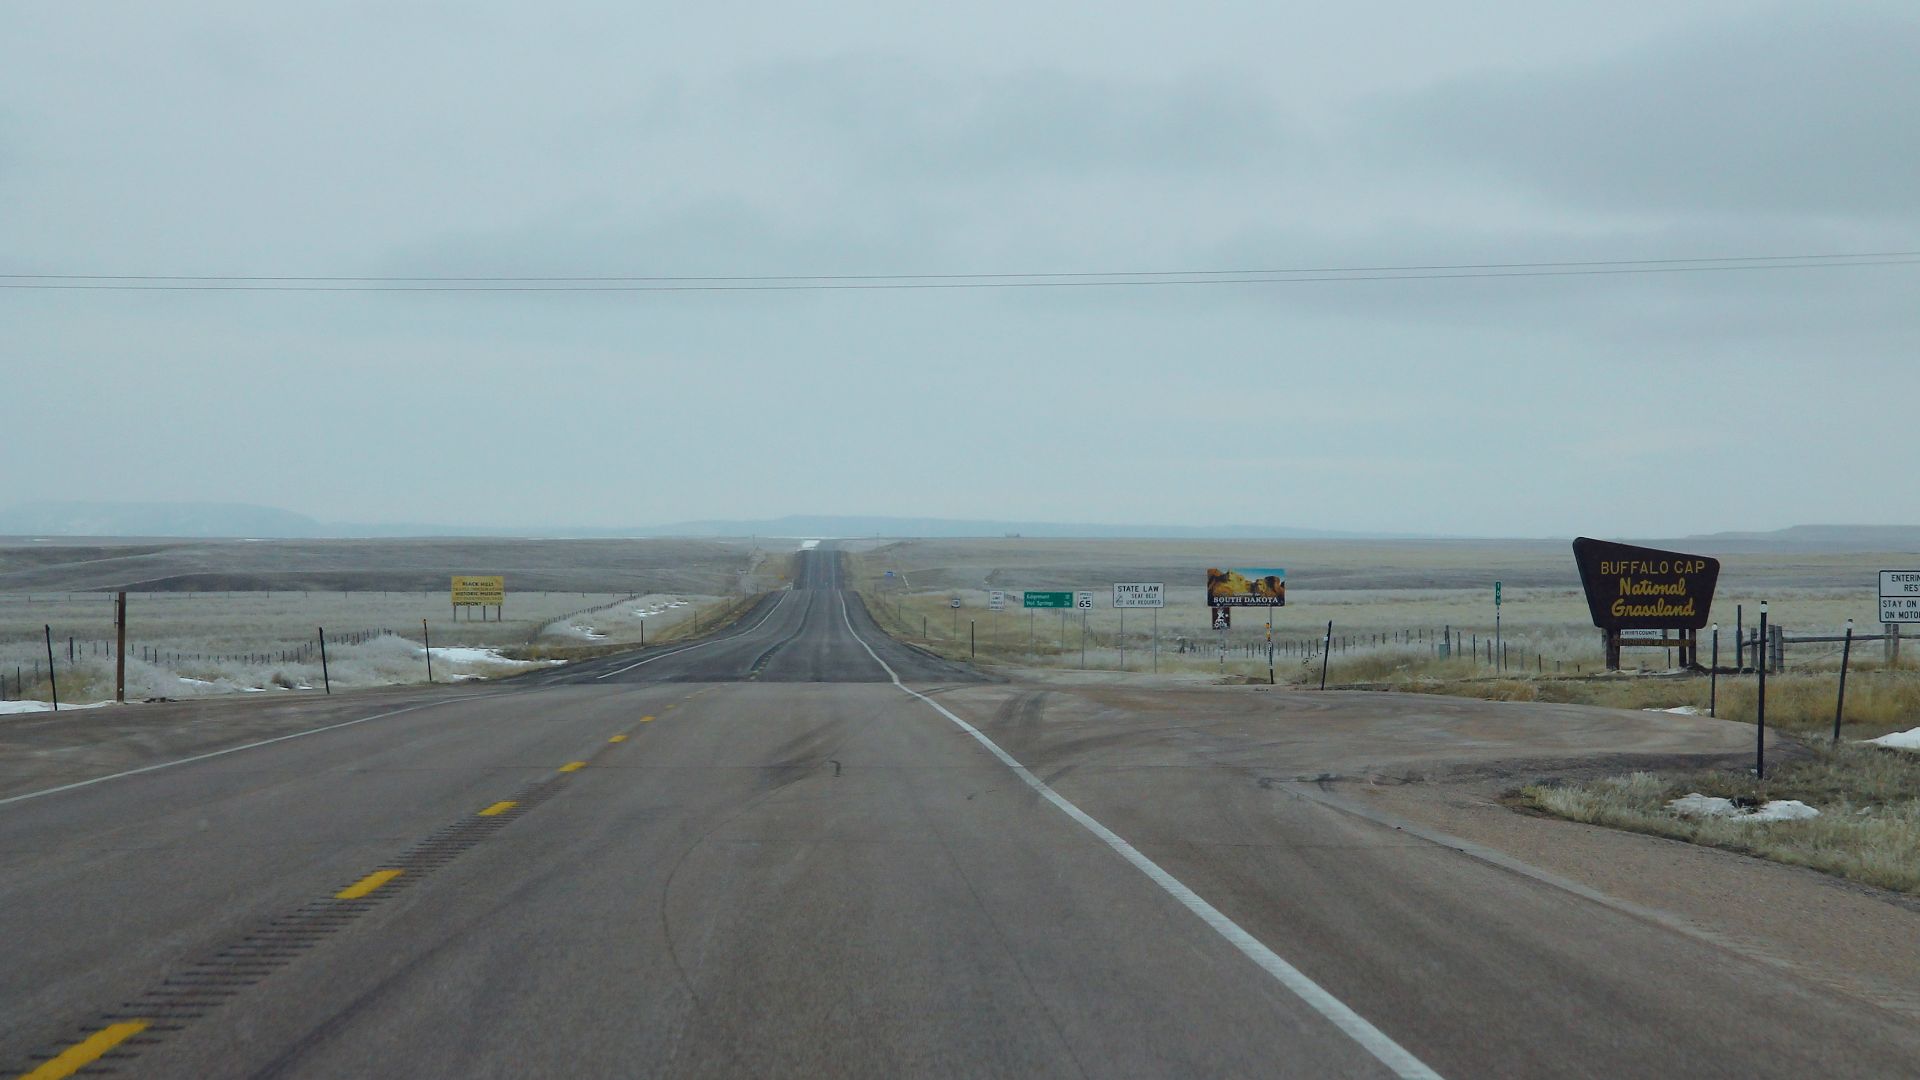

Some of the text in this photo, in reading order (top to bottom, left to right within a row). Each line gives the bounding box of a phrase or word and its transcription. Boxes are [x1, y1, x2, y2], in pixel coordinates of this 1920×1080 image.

[1600, 560, 1706, 575] BUFFALO GAP
[1117, 585, 1139, 593] STATE
[1619, 577, 1686, 596] National
[1079, 600, 1091, 608] 65
[1611, 598, 1695, 617] Grassland
[1882, 600, 1917, 608] STAY ON
[1884, 611, 1895, 619] ON
